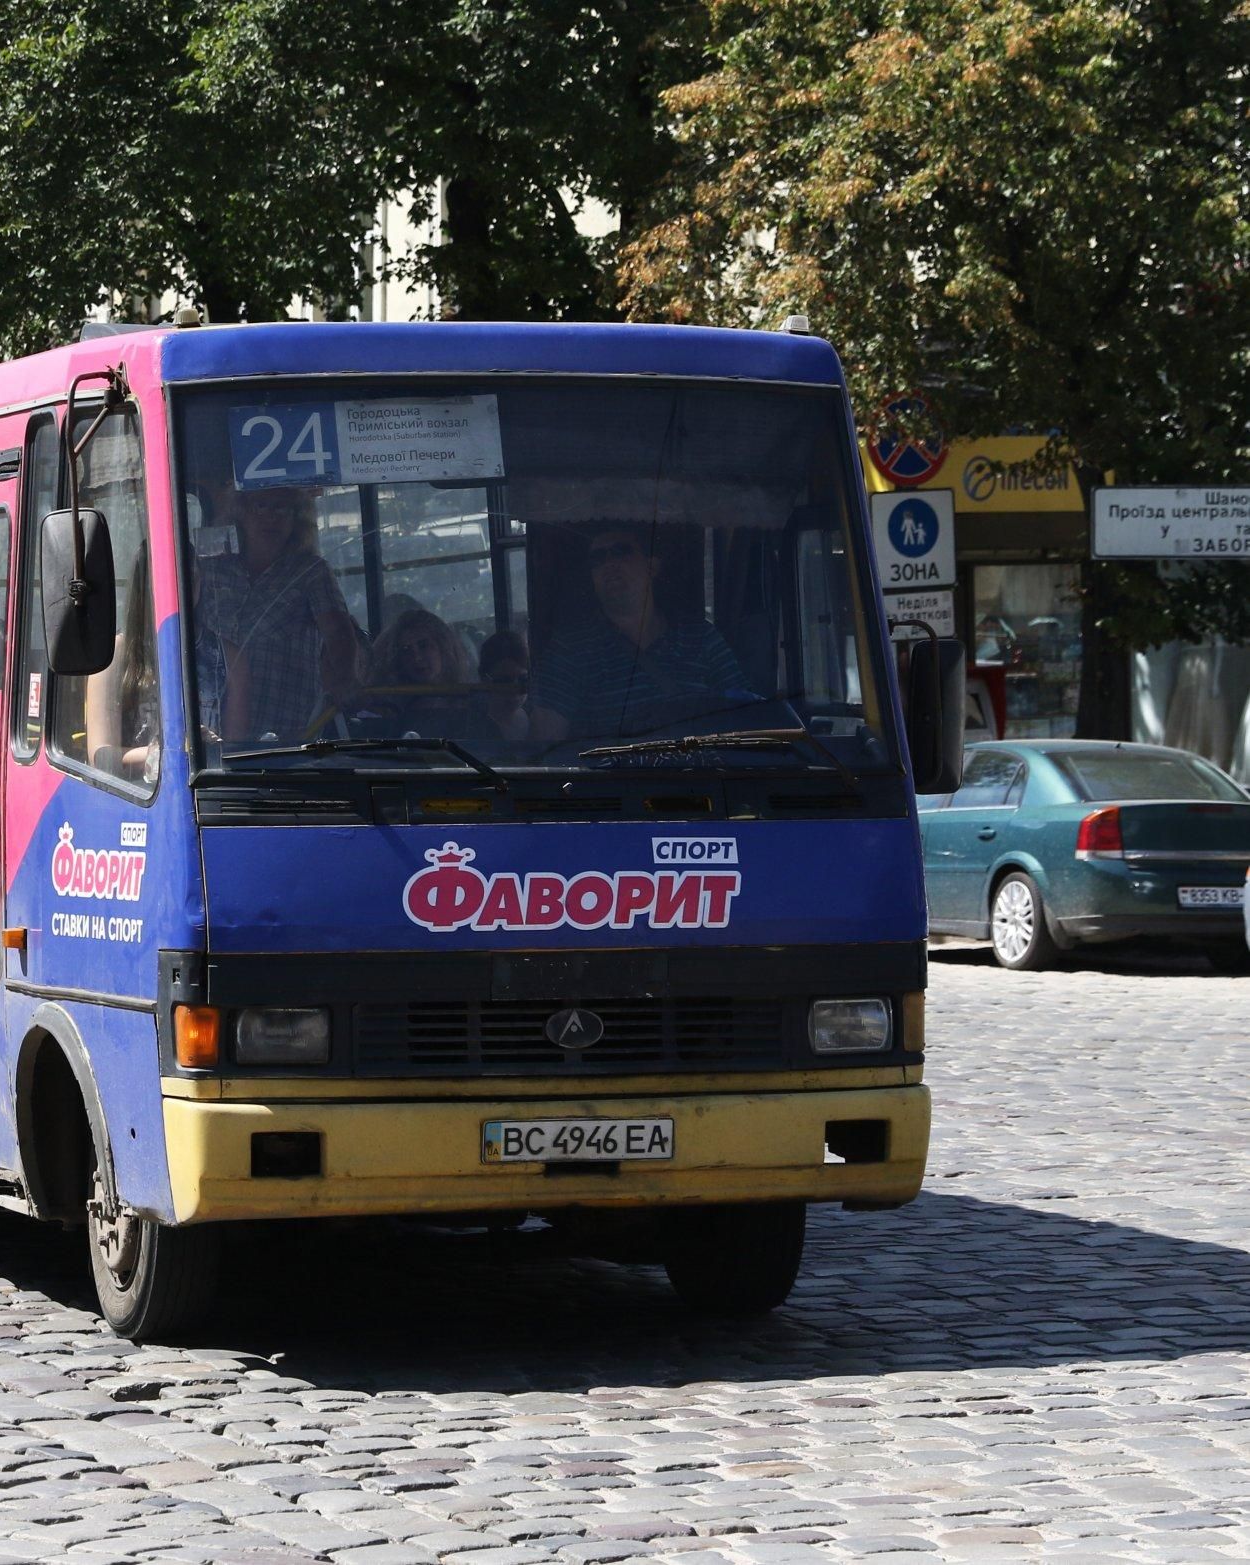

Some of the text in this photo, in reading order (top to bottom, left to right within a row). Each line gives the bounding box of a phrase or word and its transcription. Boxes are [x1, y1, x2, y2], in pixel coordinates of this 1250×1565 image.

[347, 407, 421, 421] Городоцька
[349, 417, 469, 433] Приміський вокзал
[349, 433, 392, 442] Horodotska
[393, 432, 431, 441] (Suburban
[241, 412, 332, 480] 24
[351, 450, 456, 465] Медової Печери
[1205, 492, 1250, 506] Шано
[1109, 504, 1250, 521] Проїзд централь
[891, 562, 940, 582] ЗОНА
[897, 597, 938, 610] Неділя
[123, 827, 145, 843] СПОРТ
[656, 841, 733, 860] СПОРТ
[52, 841, 146, 901] ФАВОРИТ
[403, 862, 740, 931] ФАВОРИТ
[52, 912, 143, 943] СТАВКИ НА СПОРТ
[504, 1125, 667, 1156] BC 4946 EA
